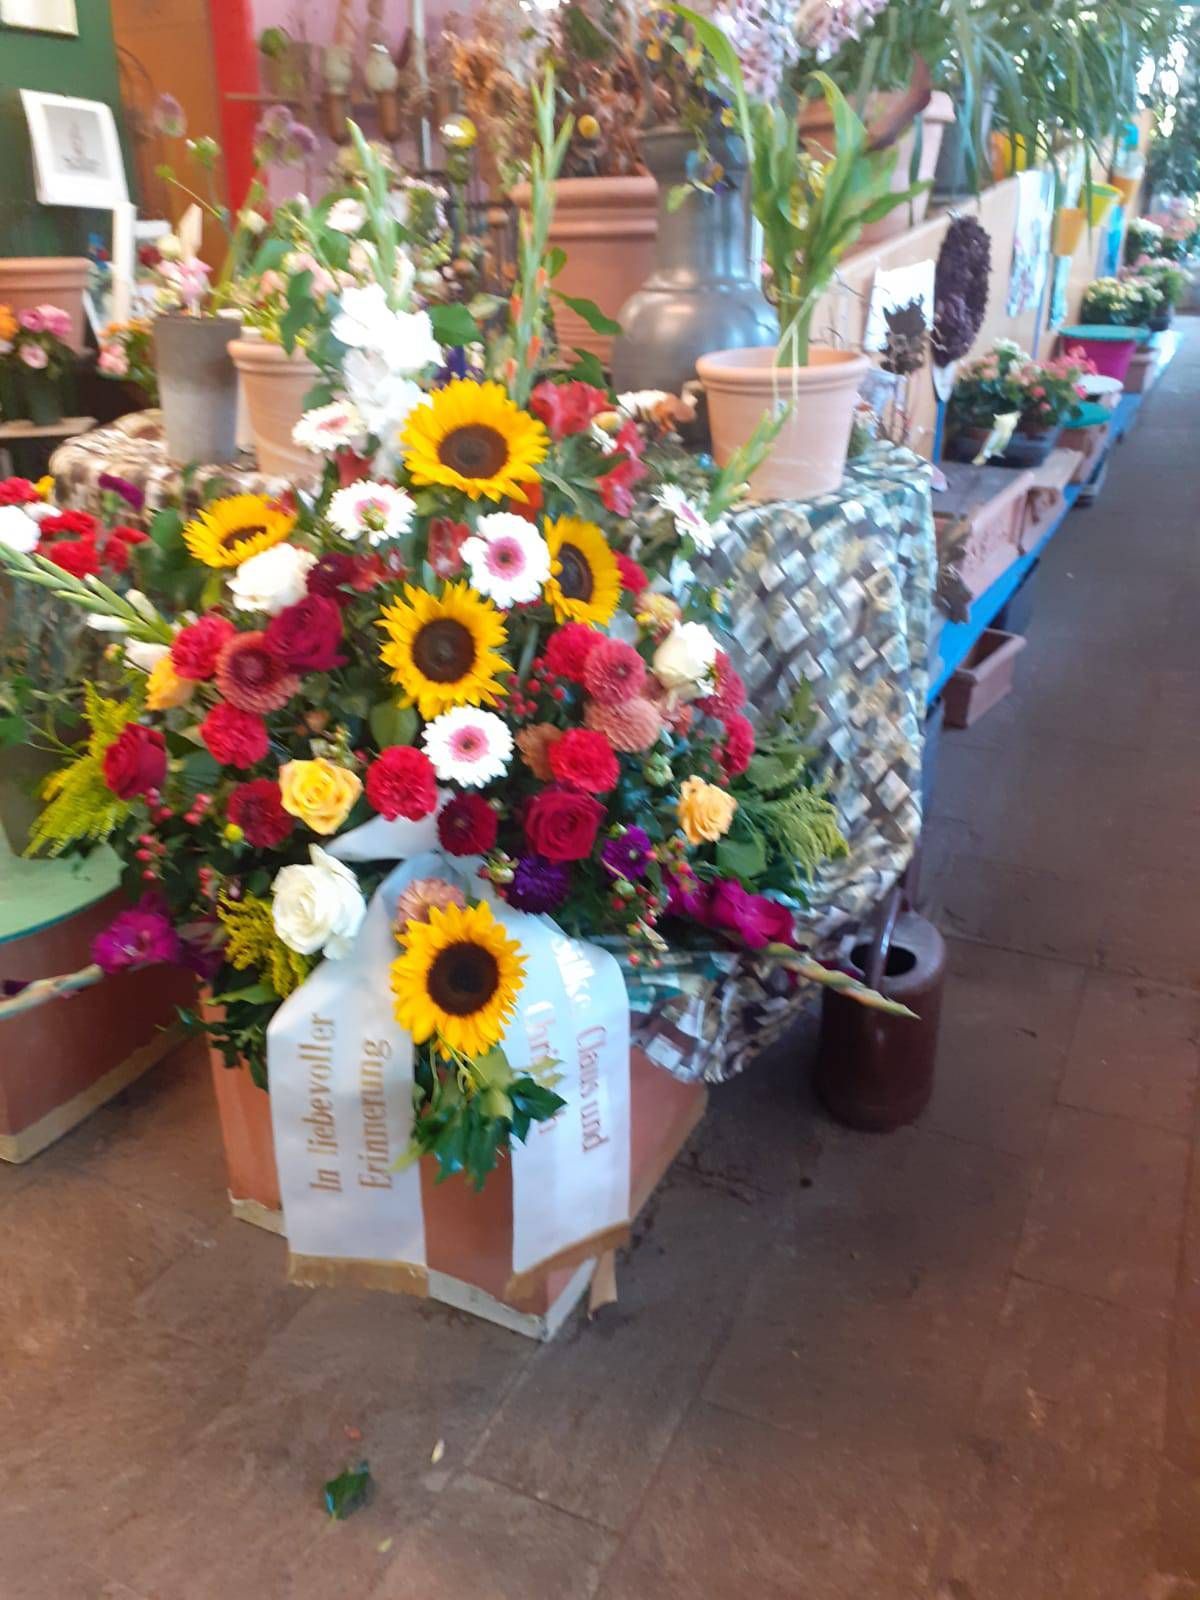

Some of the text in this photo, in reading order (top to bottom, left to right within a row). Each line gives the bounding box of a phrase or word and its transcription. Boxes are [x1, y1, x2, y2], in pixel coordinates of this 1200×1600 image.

[297, 1012, 343, 1193] In liebevoller
[358, 1039, 393, 1190] Erinnerung
[580, 1101, 609, 1152] und
